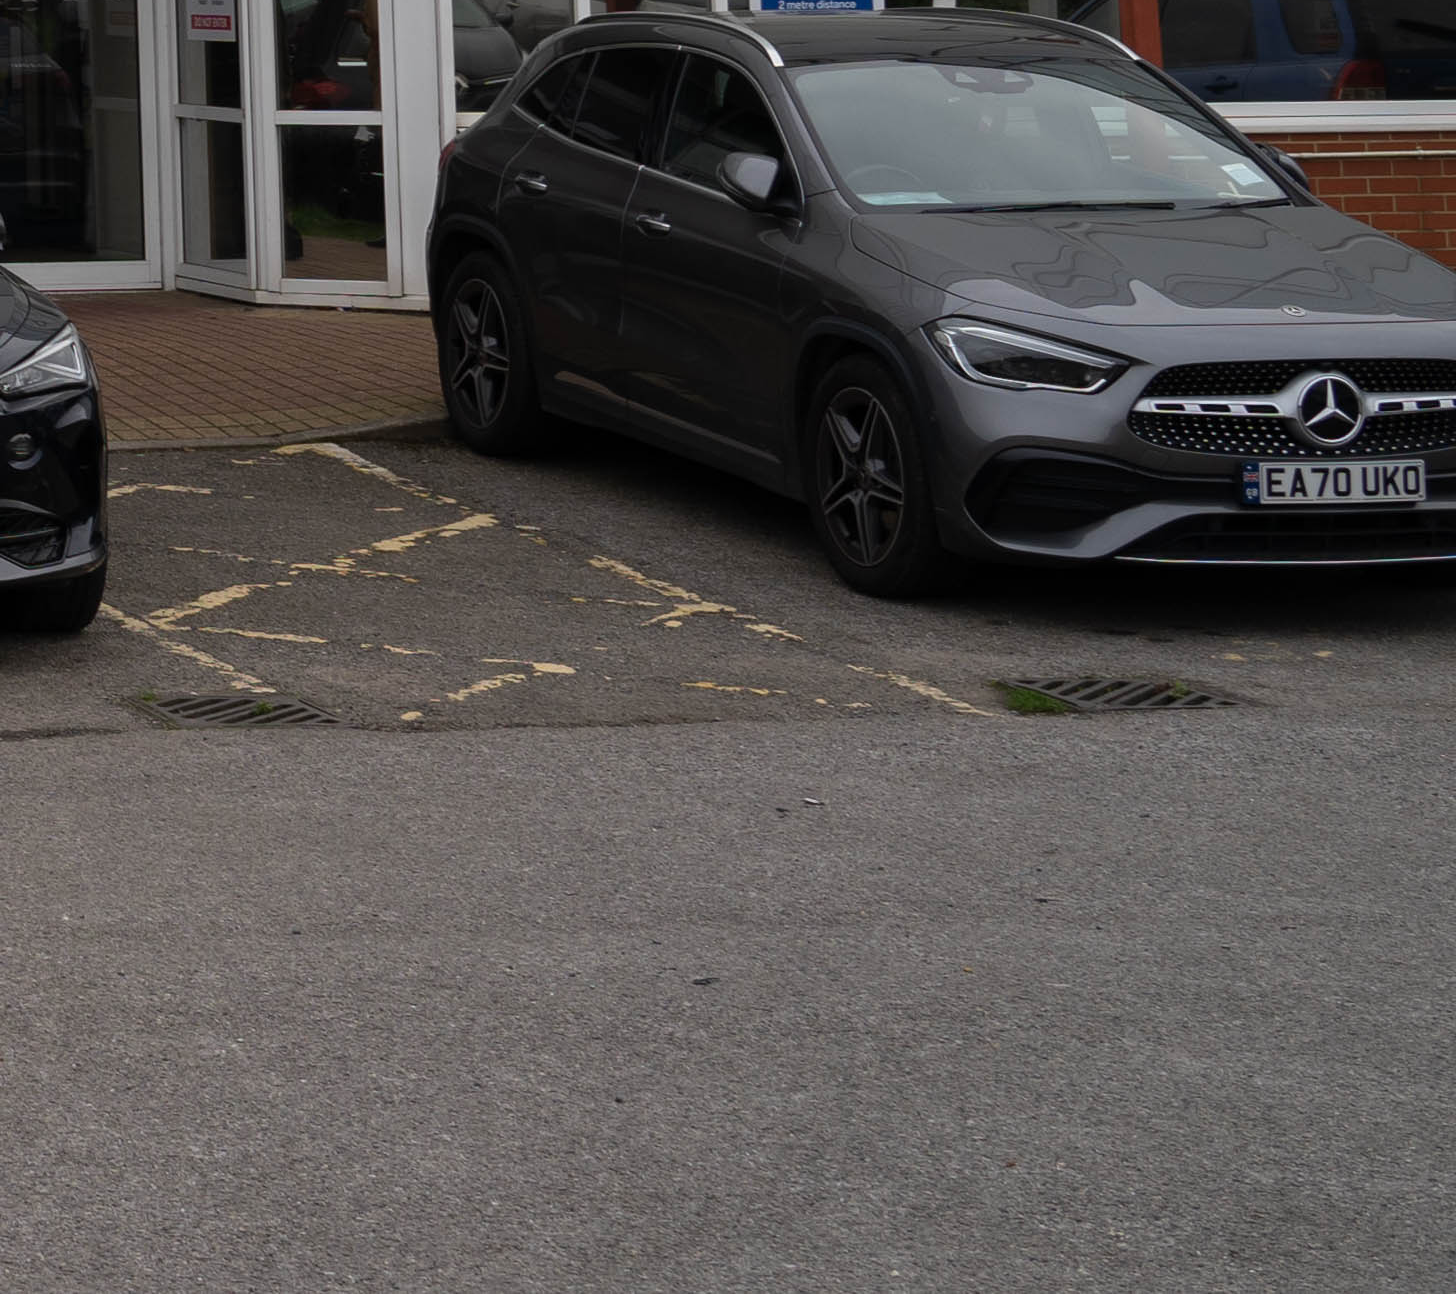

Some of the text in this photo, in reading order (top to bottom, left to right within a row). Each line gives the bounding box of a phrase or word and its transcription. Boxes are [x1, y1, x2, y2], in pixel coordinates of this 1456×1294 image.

[778, 0, 857, 10] 2 metre distance
[1266, 466, 1421, 498] EA70 UKO
